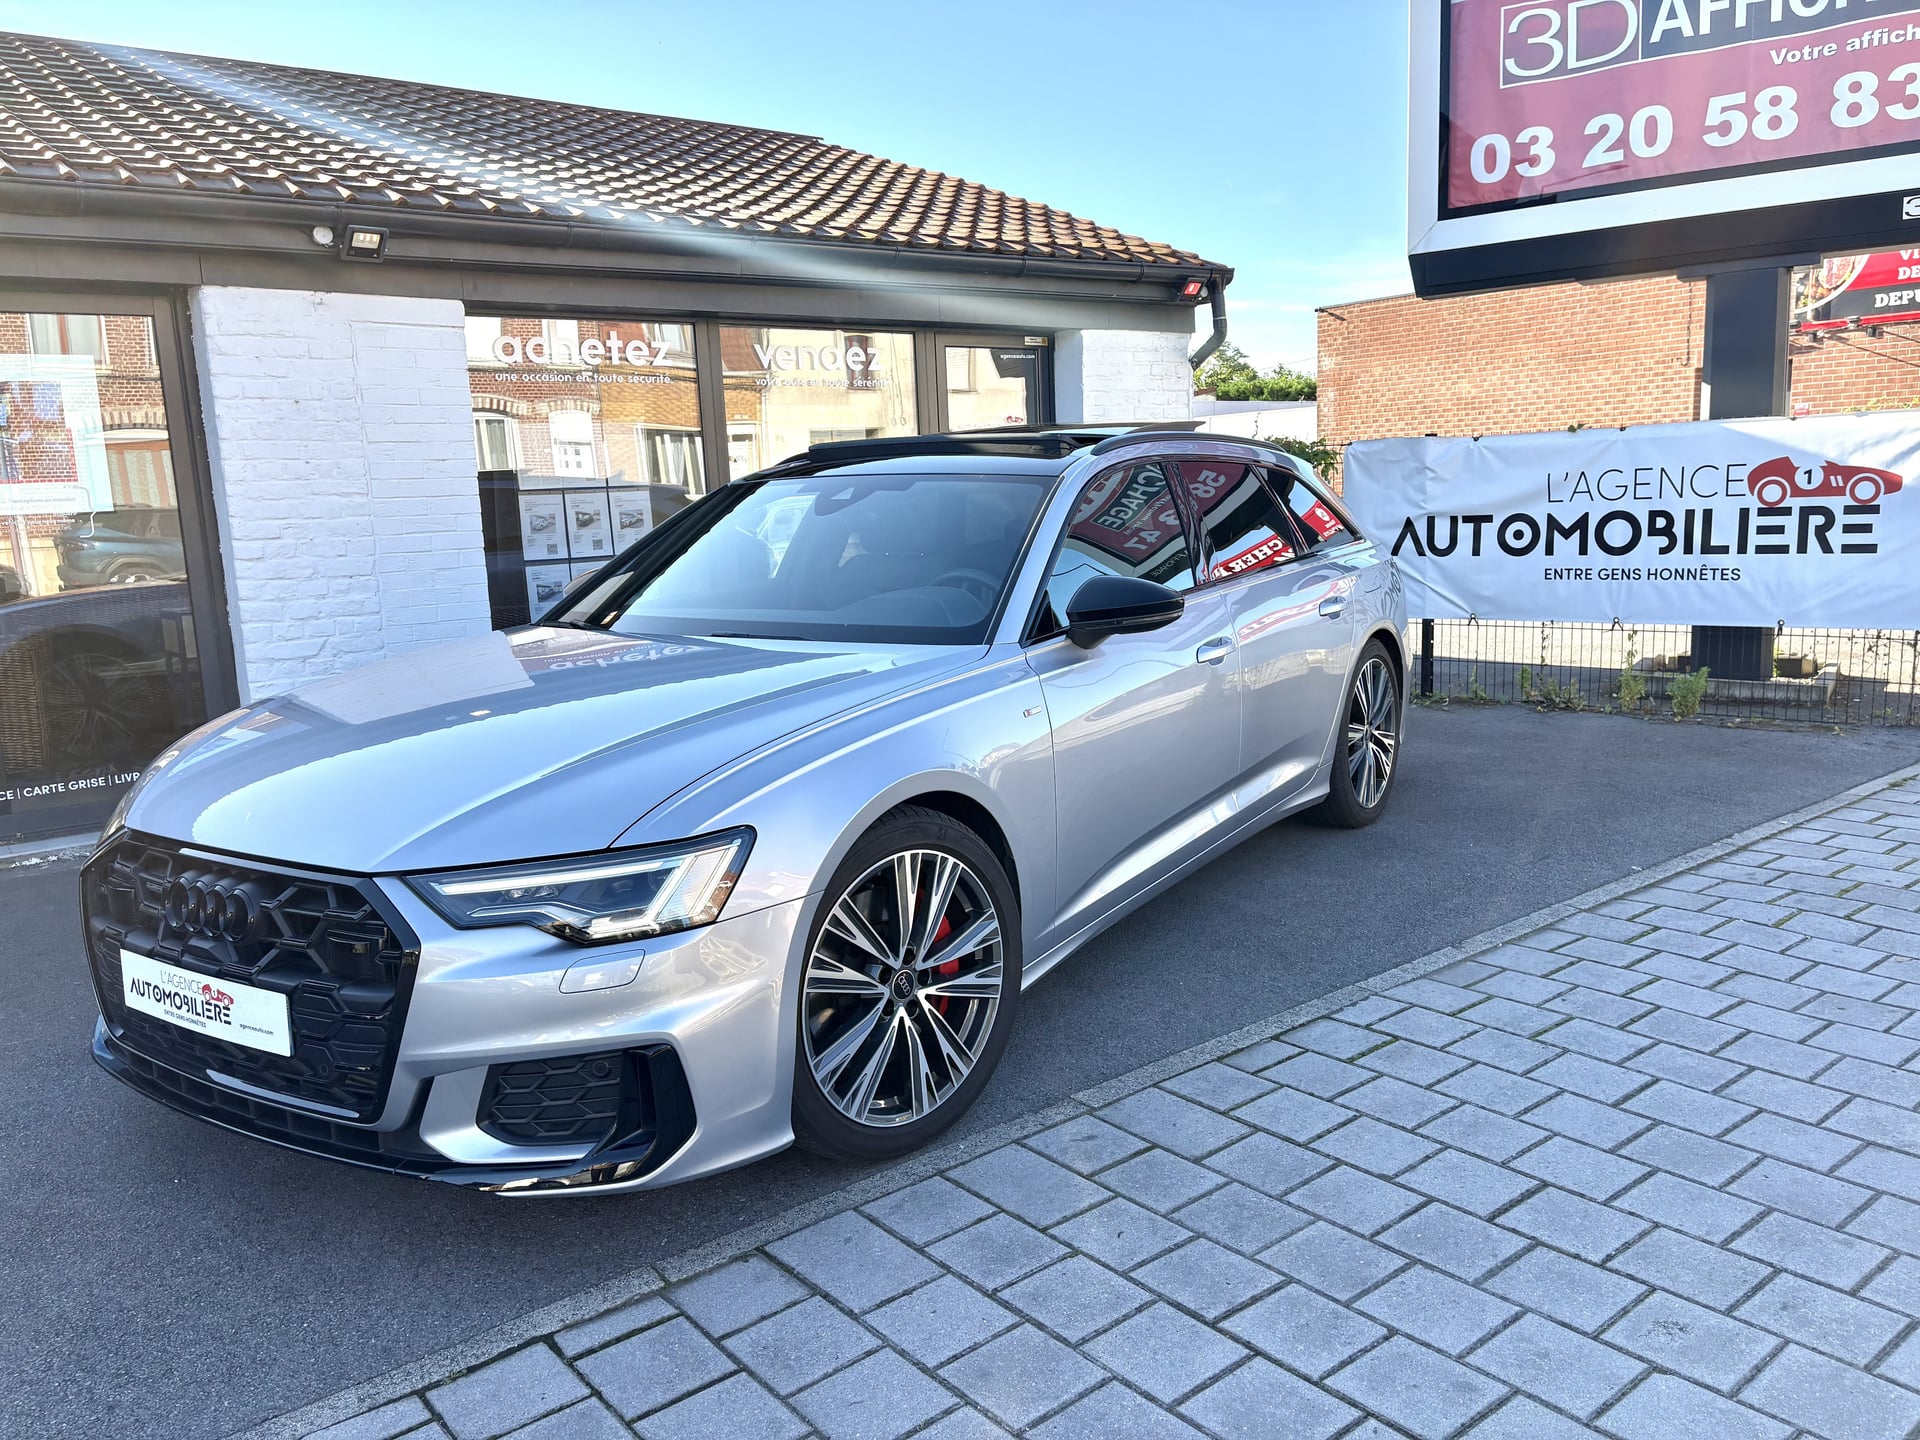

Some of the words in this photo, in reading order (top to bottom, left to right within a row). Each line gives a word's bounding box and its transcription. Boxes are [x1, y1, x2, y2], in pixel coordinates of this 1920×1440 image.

[1504, 0, 1639, 77] 3D
[1650, 0, 1877, 43] AFF
[1769, 43, 1838, 66] Votre
[1470, 126, 1556, 184] 03
[1582, 104, 1673, 168] 20
[1702, 85, 1799, 147] 58
[1829, 62, 1920, 128] 83
[493, 331, 673, 366] achetez
[753, 344, 883, 371] vendez
[495, 374, 517, 382] une
[522, 371, 572, 383] occasion
[1546, 463, 1747, 503] L'AGENCE
[1544, 567, 1592, 581] ENTRE
[1597, 567, 1641, 582] GENS
[1647, 564, 1741, 582] HONNÊTES
[23, 782, 66, 797] CARTE
[68, 777, 107, 791] GRISE
